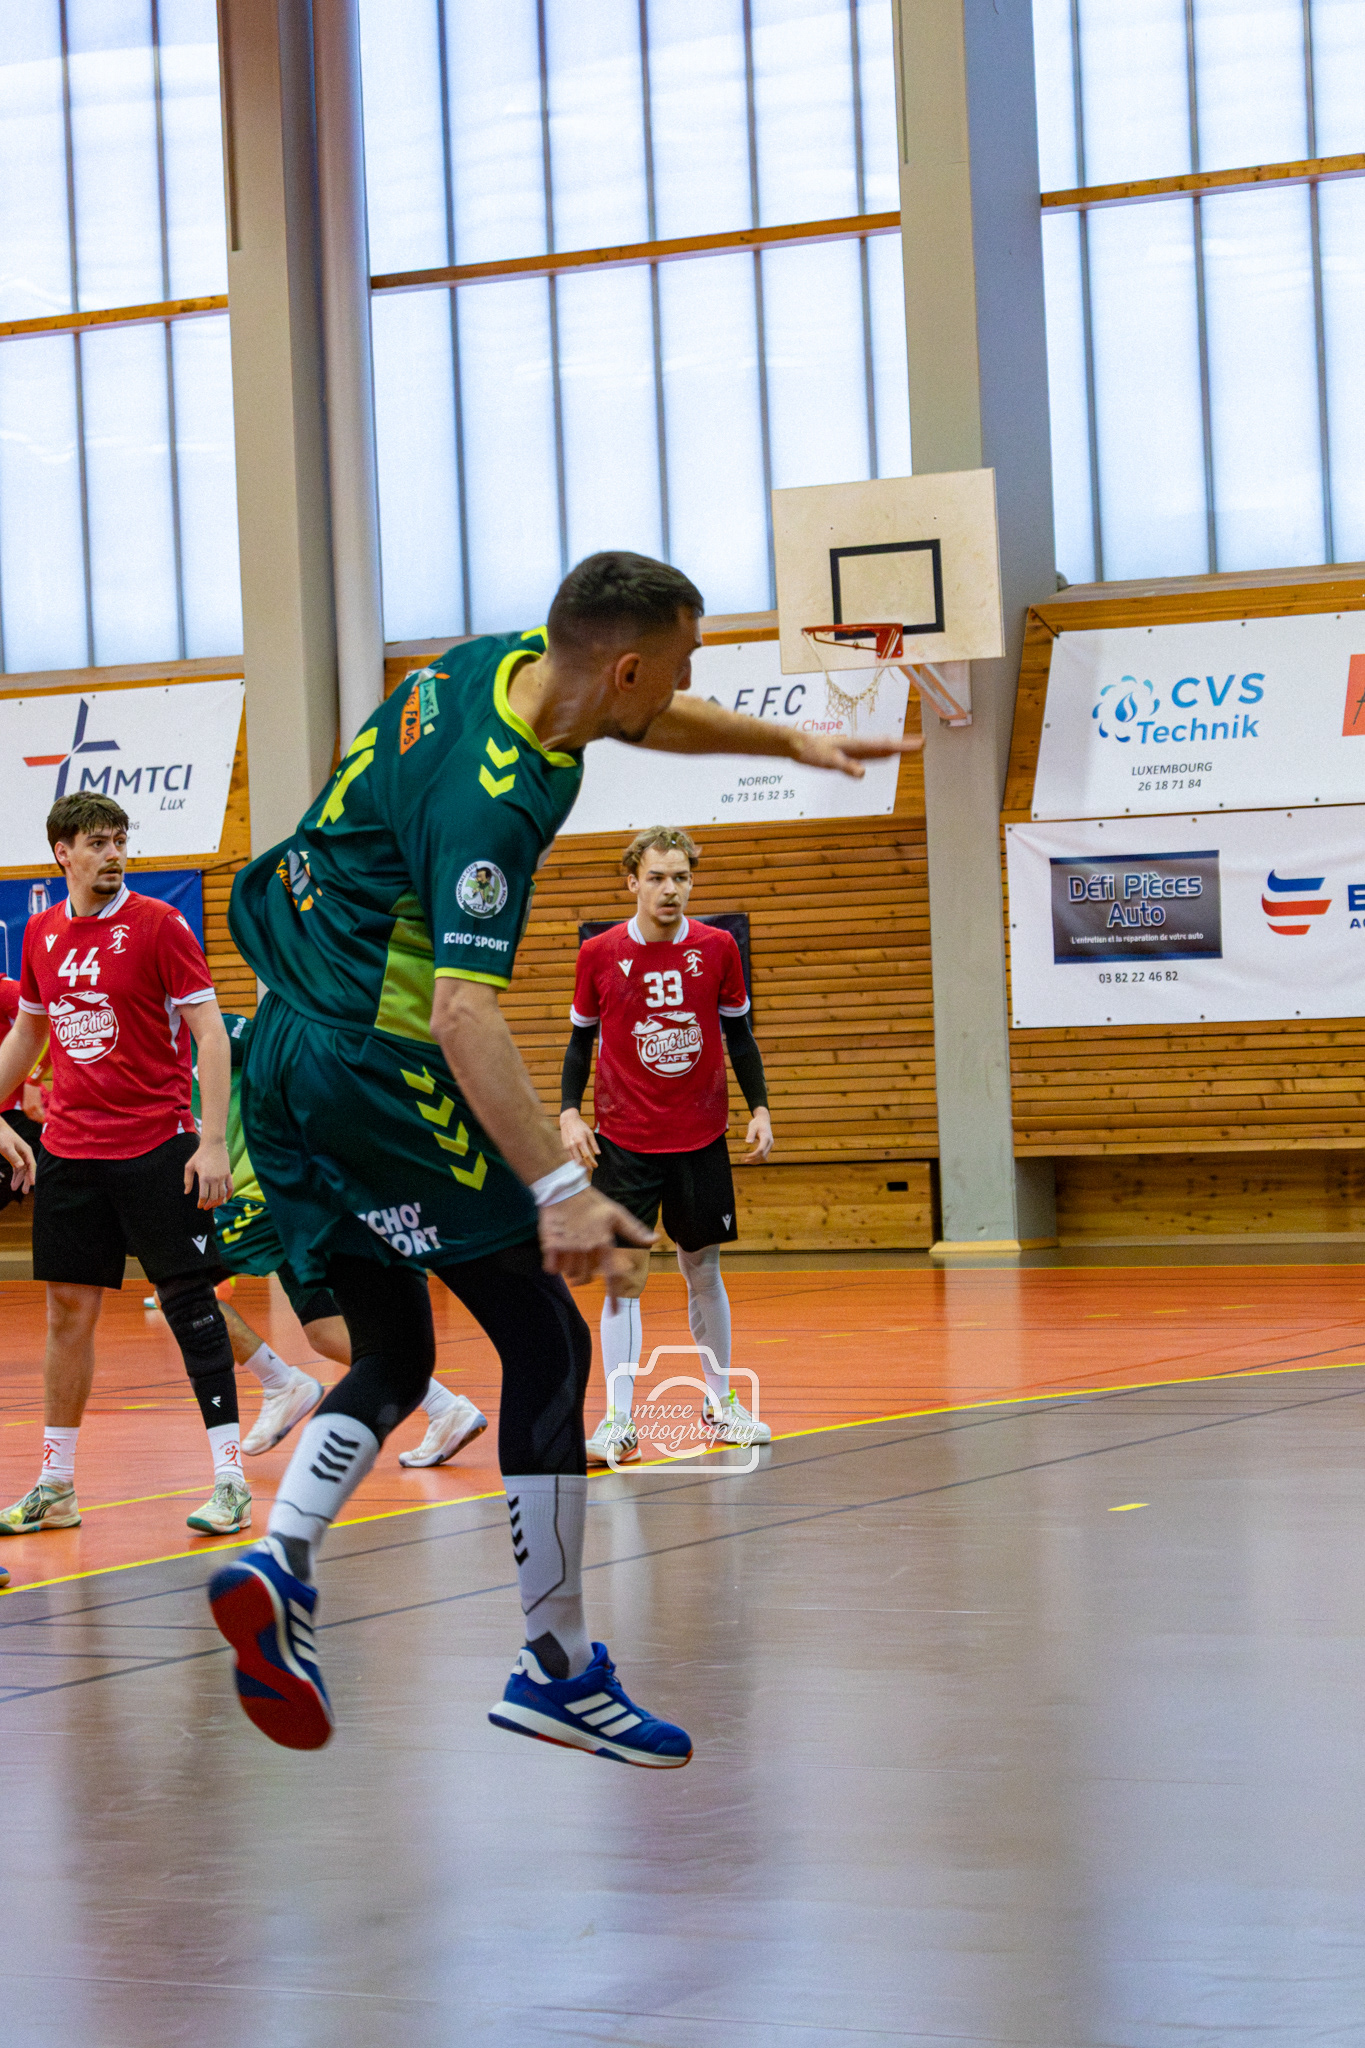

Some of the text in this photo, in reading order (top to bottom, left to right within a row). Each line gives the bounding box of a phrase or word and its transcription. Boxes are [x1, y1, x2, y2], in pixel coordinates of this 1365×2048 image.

[1171, 672, 1266, 709] CVS
[802, 720, 844, 735] Chape
[1136, 714, 1260, 744] Technik
[1131, 762, 1213, 776] LUXEMBOURG
[79, 764, 193, 796] MMTCI
[738, 775, 784, 787] NORROY
[1138, 779, 1202, 791] 26 18 71 84
[160, 796, 186, 811] Lux
[721, 789, 796, 803] 06 73 16 32 35
[1068, 872, 1203, 902] Défi Pièces
[1107, 900, 1166, 928] Auto
[443, 932, 509, 953] ECHO'SPORT
[1160, 933, 1169, 941] de
[1169, 933, 1187, 941] votre
[1188, 932, 1204, 940] auto
[58, 947, 101, 987] 44
[1099, 971, 1179, 984] 03 82 22 46 82
[644, 970, 684, 1008] 33
[69, 1039, 102, 1048] CAFE
[659, 1054, 690, 1063] CAFE
[357, 1202, 421, 1235] CHO'
[382, 1226, 442, 1258] ORT
